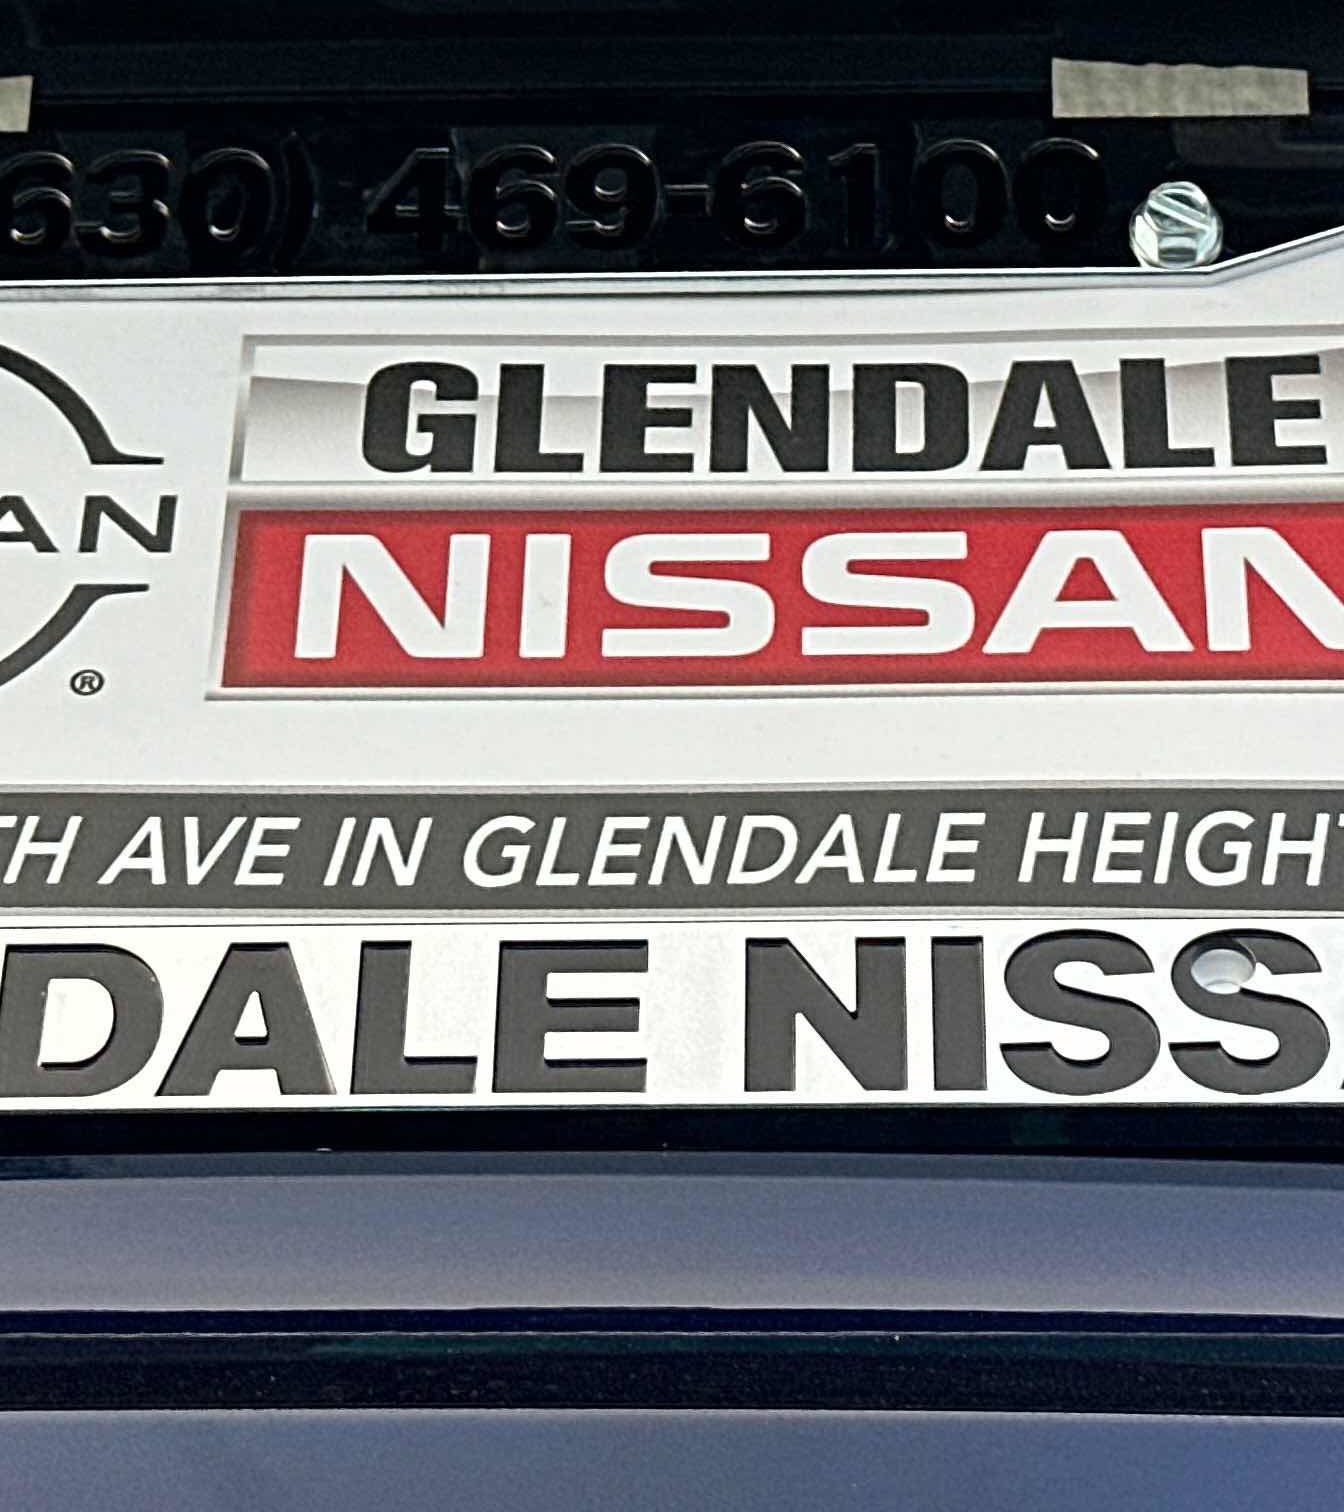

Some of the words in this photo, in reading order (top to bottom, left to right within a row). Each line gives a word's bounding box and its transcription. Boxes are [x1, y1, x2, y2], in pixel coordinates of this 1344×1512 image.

[364, 136, 1102, 256] 469-6100
[359, 353, 1329, 474] GLENDALE
[98, 812, 302, 889] AVE
[321, 812, 435, 888] IN
[461, 812, 980, 890] GLENDALE
